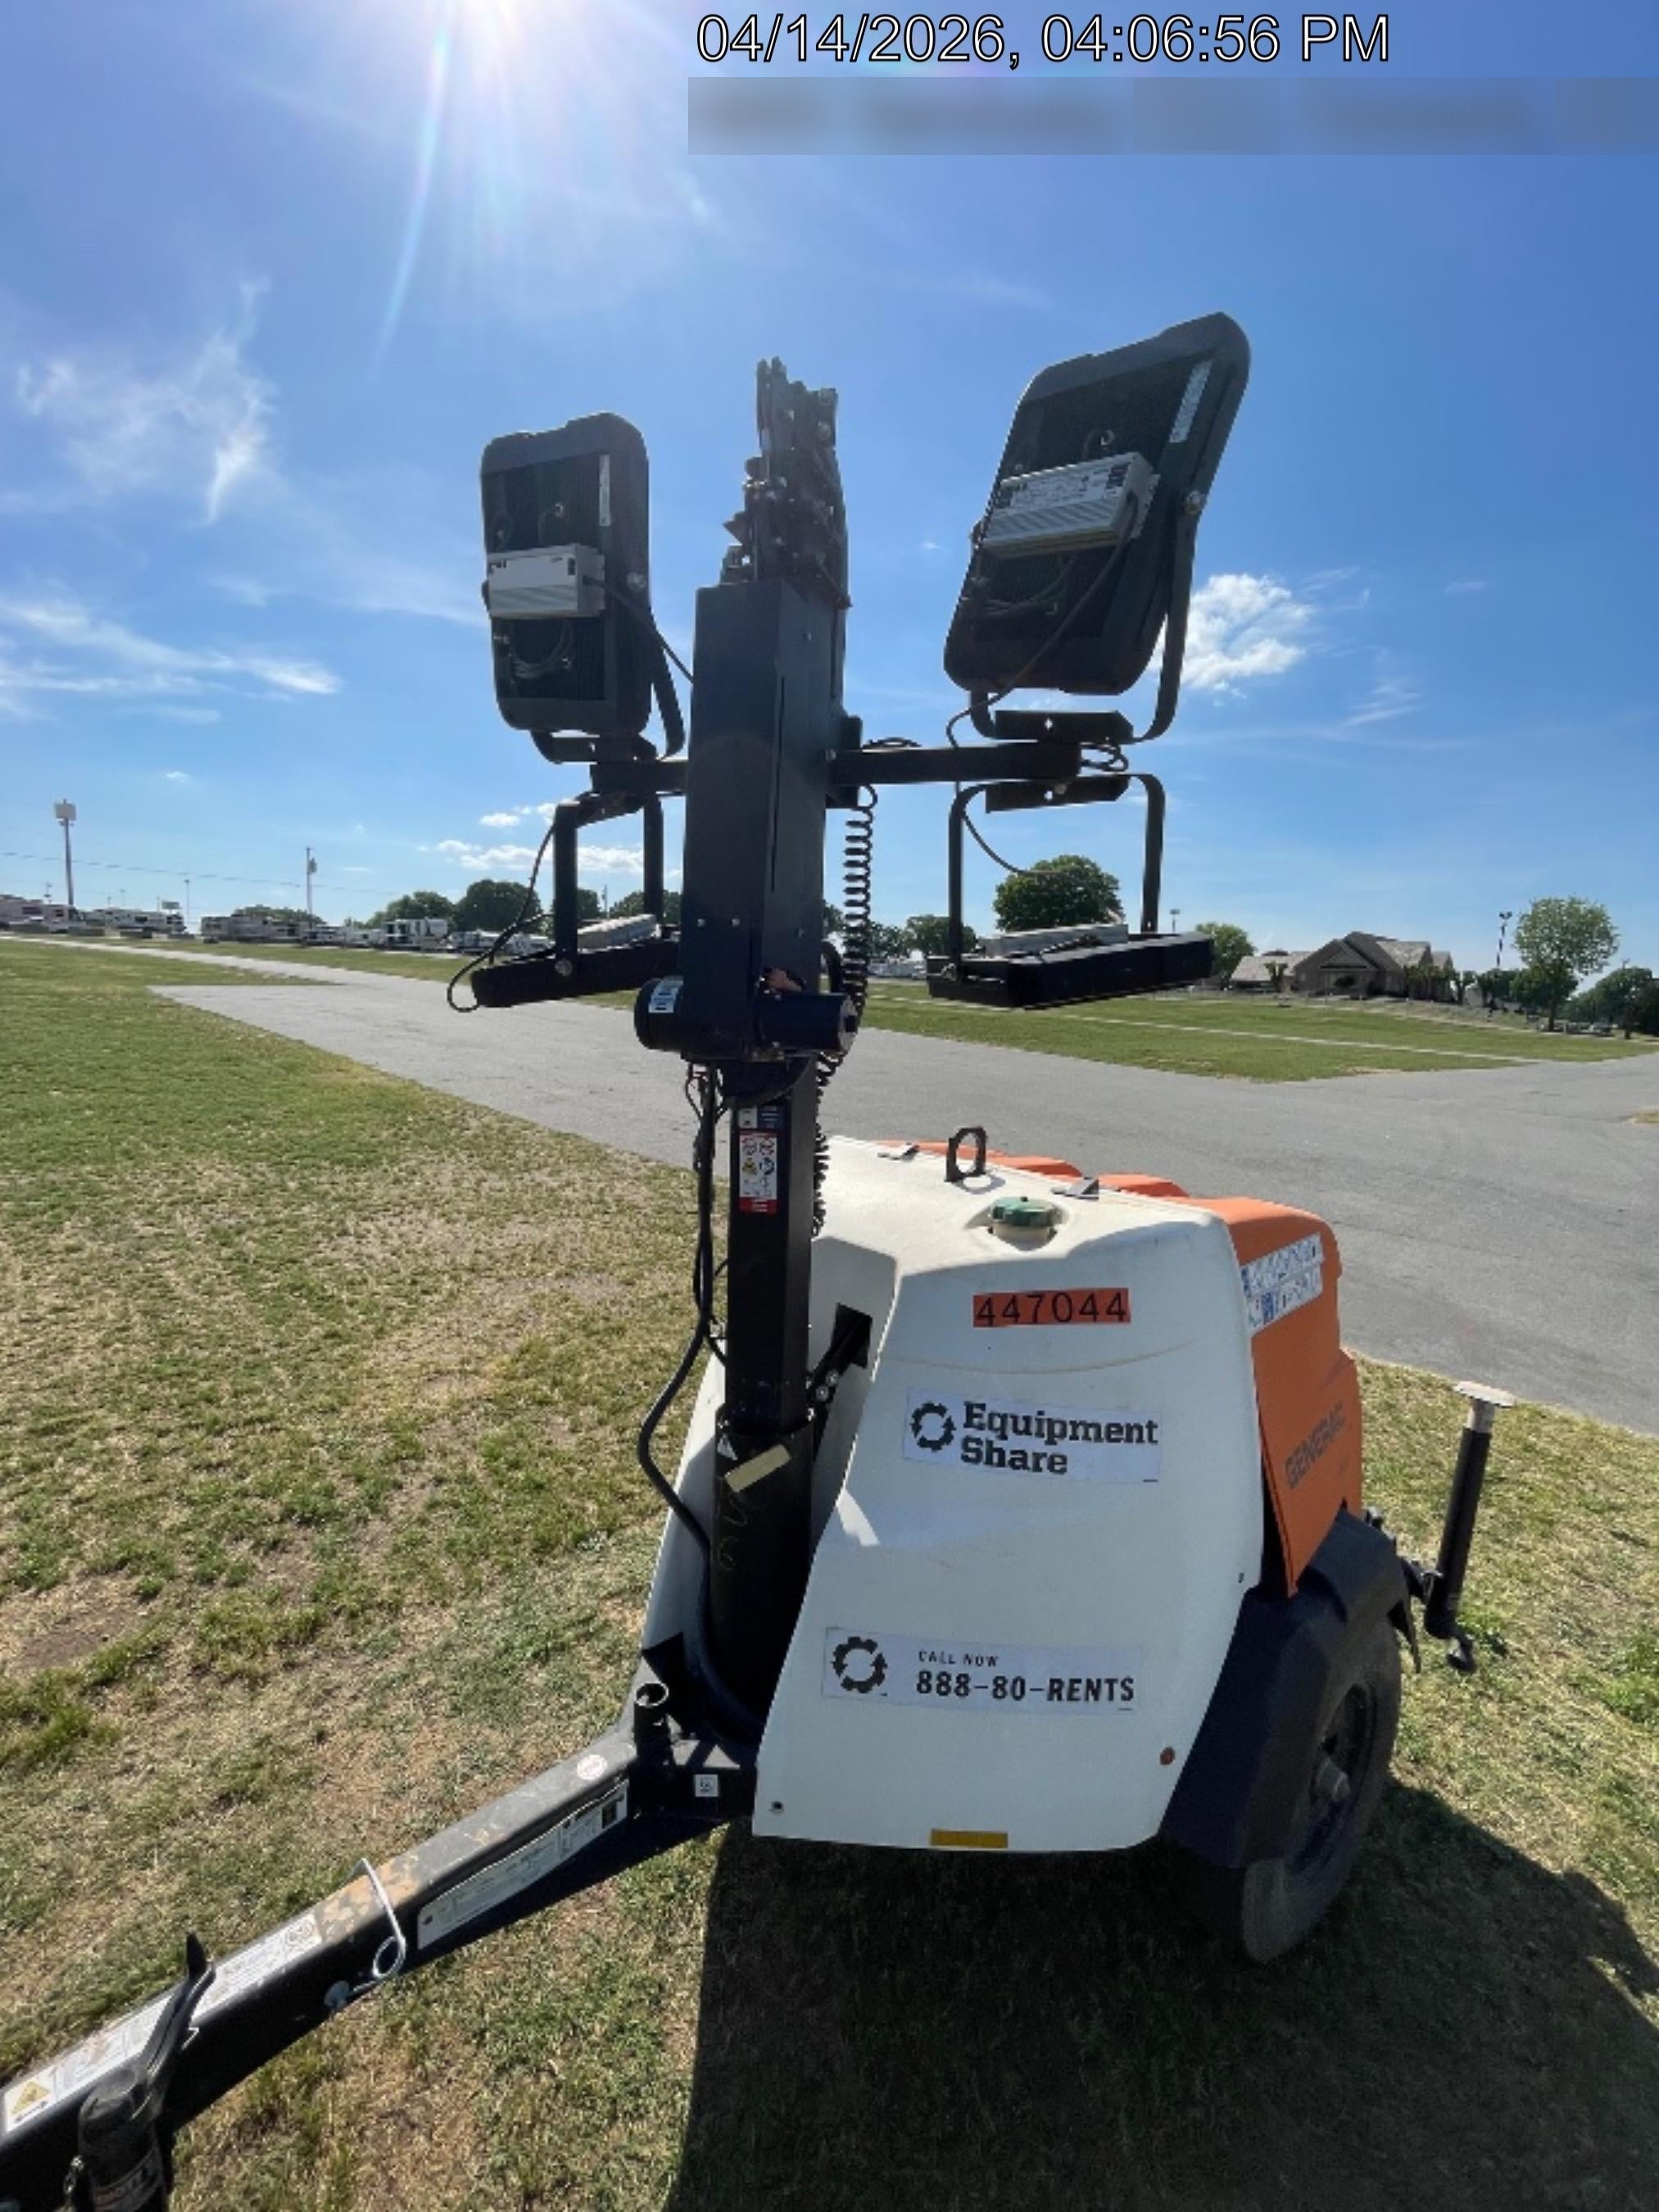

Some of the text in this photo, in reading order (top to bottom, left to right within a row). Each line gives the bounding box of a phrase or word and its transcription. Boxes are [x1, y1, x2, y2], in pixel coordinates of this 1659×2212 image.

[976, 1291, 1126, 1326] 447044
[963, 1400, 1158, 1446] Equipment
[960, 1435, 1068, 1475] Share
[918, 1650, 999, 1667] CALL NOW
[916, 1670, 1135, 1702] 888-80-RENTS
